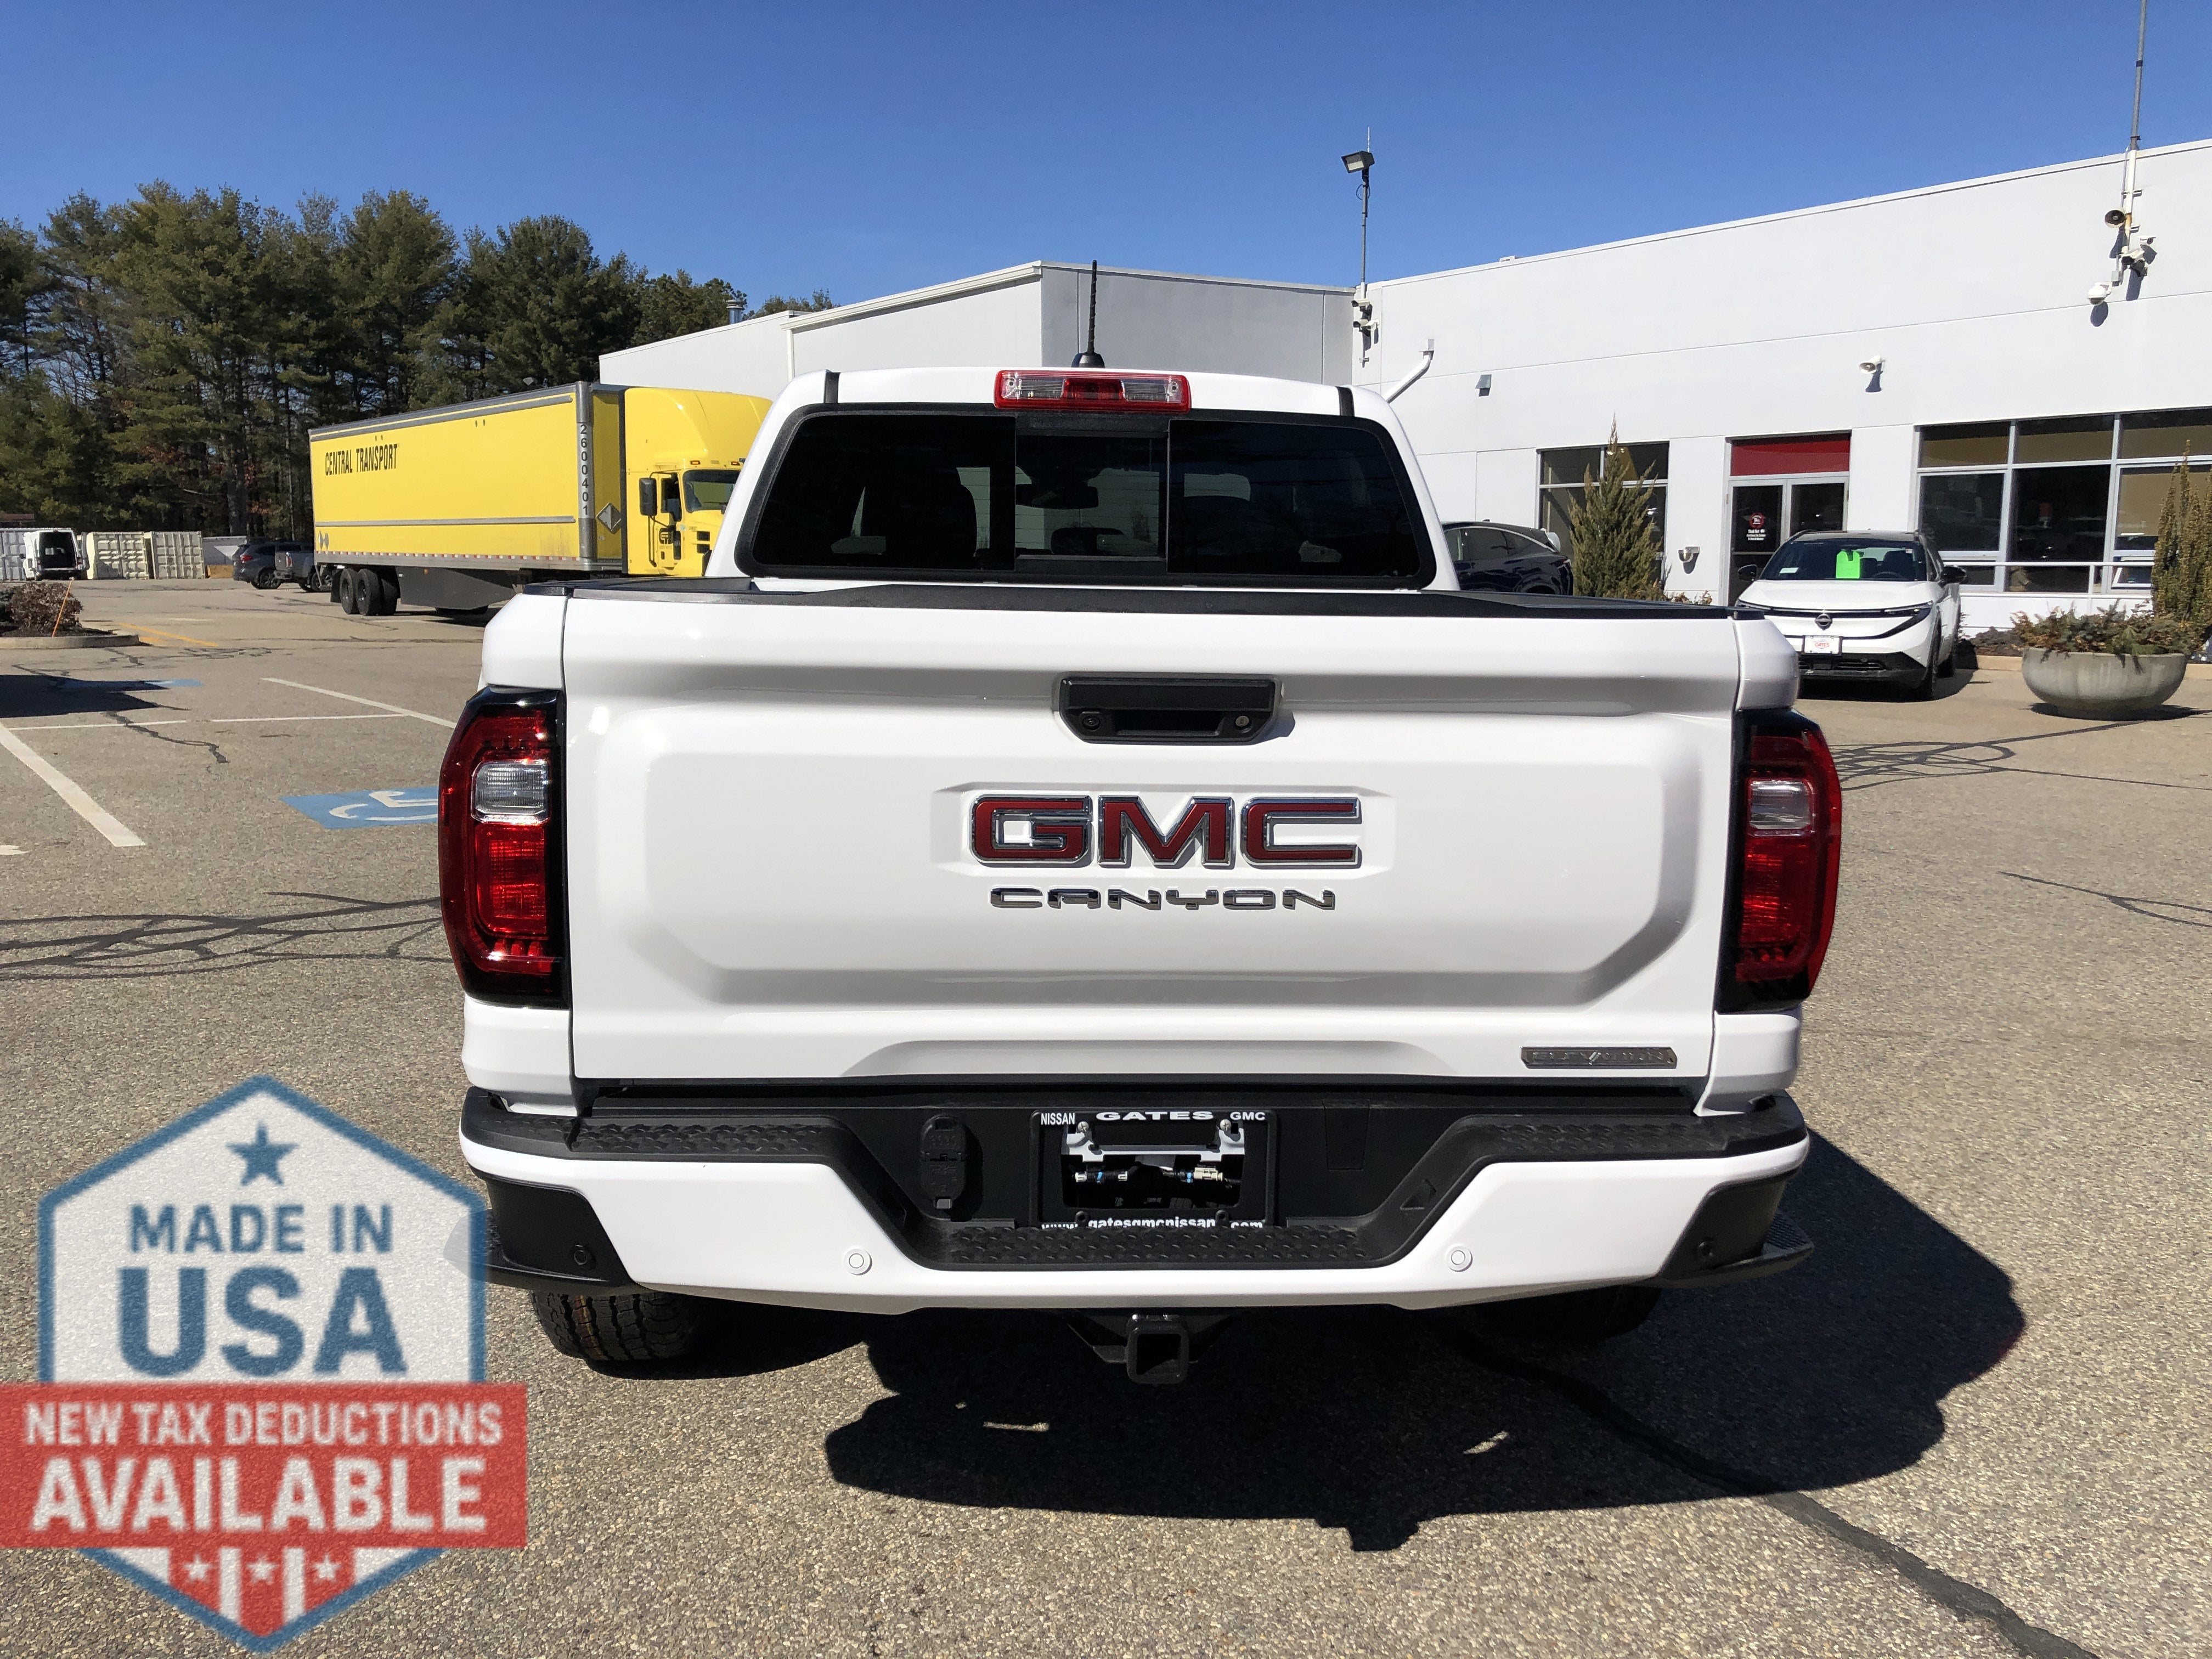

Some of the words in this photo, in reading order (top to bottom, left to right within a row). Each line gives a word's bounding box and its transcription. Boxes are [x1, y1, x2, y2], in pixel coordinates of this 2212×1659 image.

[325, 449, 353, 476] CENTRAL
[356, 443, 398, 472] TRANSPORT
[580, 424, 589, 515] 2600401
[969, 794, 1363, 869] GMC
[989, 885, 1336, 911] CANYON
[1041, 1113, 1075, 1125] NISSAN
[1096, 1111, 1214, 1121] GATES
[1229, 1111, 1266, 1121] GMC
